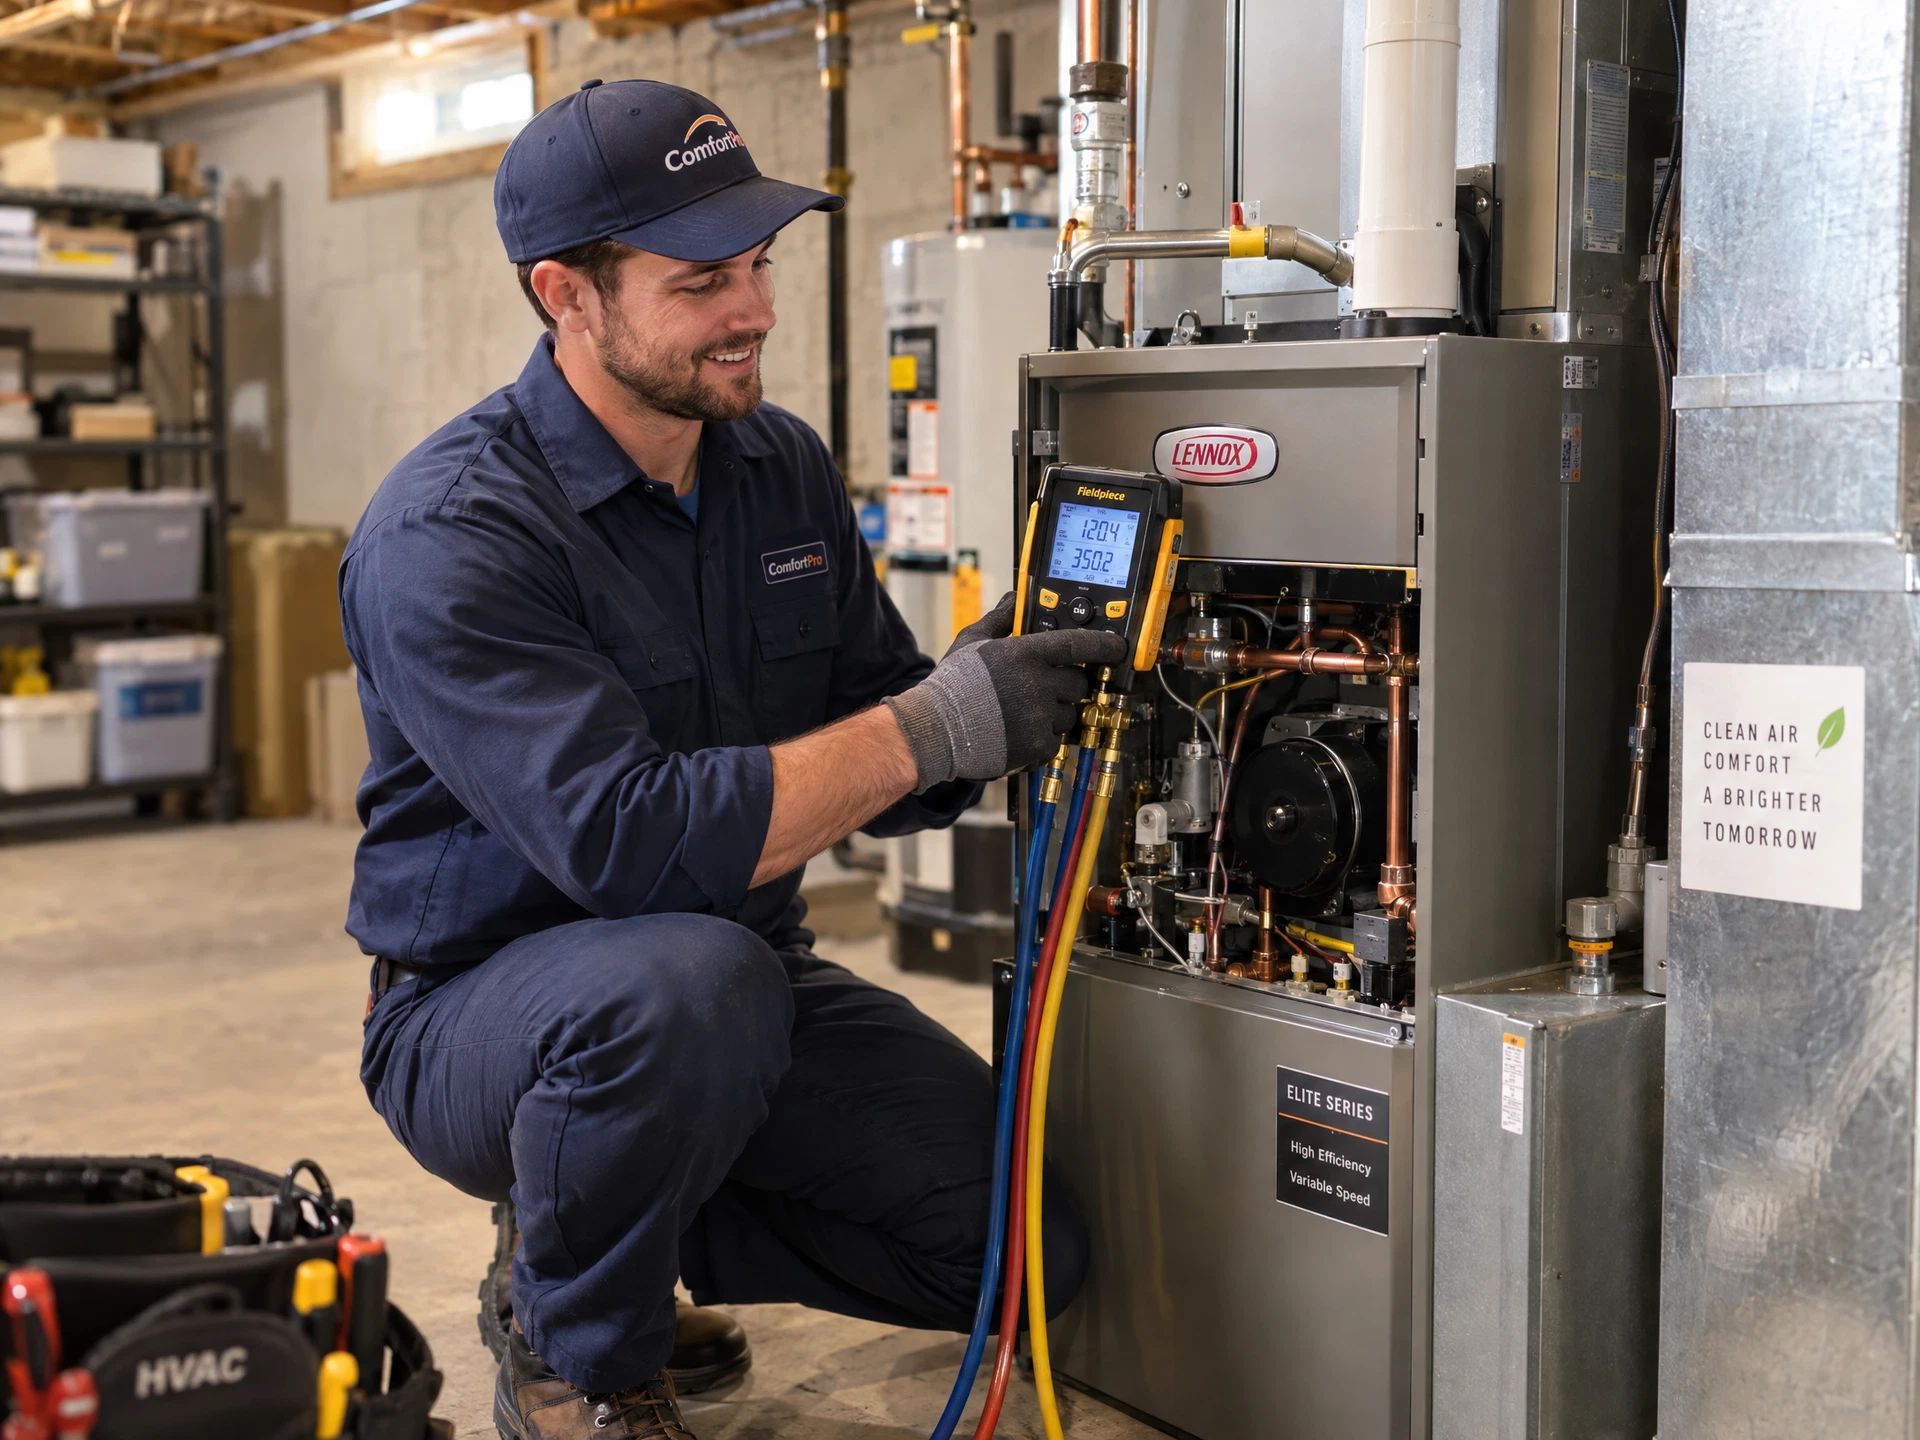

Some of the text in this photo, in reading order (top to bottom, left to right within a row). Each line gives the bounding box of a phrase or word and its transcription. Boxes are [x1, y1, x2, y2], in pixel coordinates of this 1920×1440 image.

[1171, 443, 1245, 466] LENNOX
[1077, 486, 1126, 501] Fieldpiece
[768, 554, 823, 576] ComfortPro
[1703, 721, 1798, 743] CLEAN AIR
[1703, 752, 1791, 774] COMFORT
[1703, 786, 1822, 813] A BRIGHTER
[1703, 821, 1817, 850] TOMORROW
[1287, 1084, 1373, 1121] ELITE SERIES
[1291, 1140, 1371, 1178] High Efficiency
[1290, 1170, 1371, 1207] Variable Speed
[135, 1346, 248, 1399] HVAC
